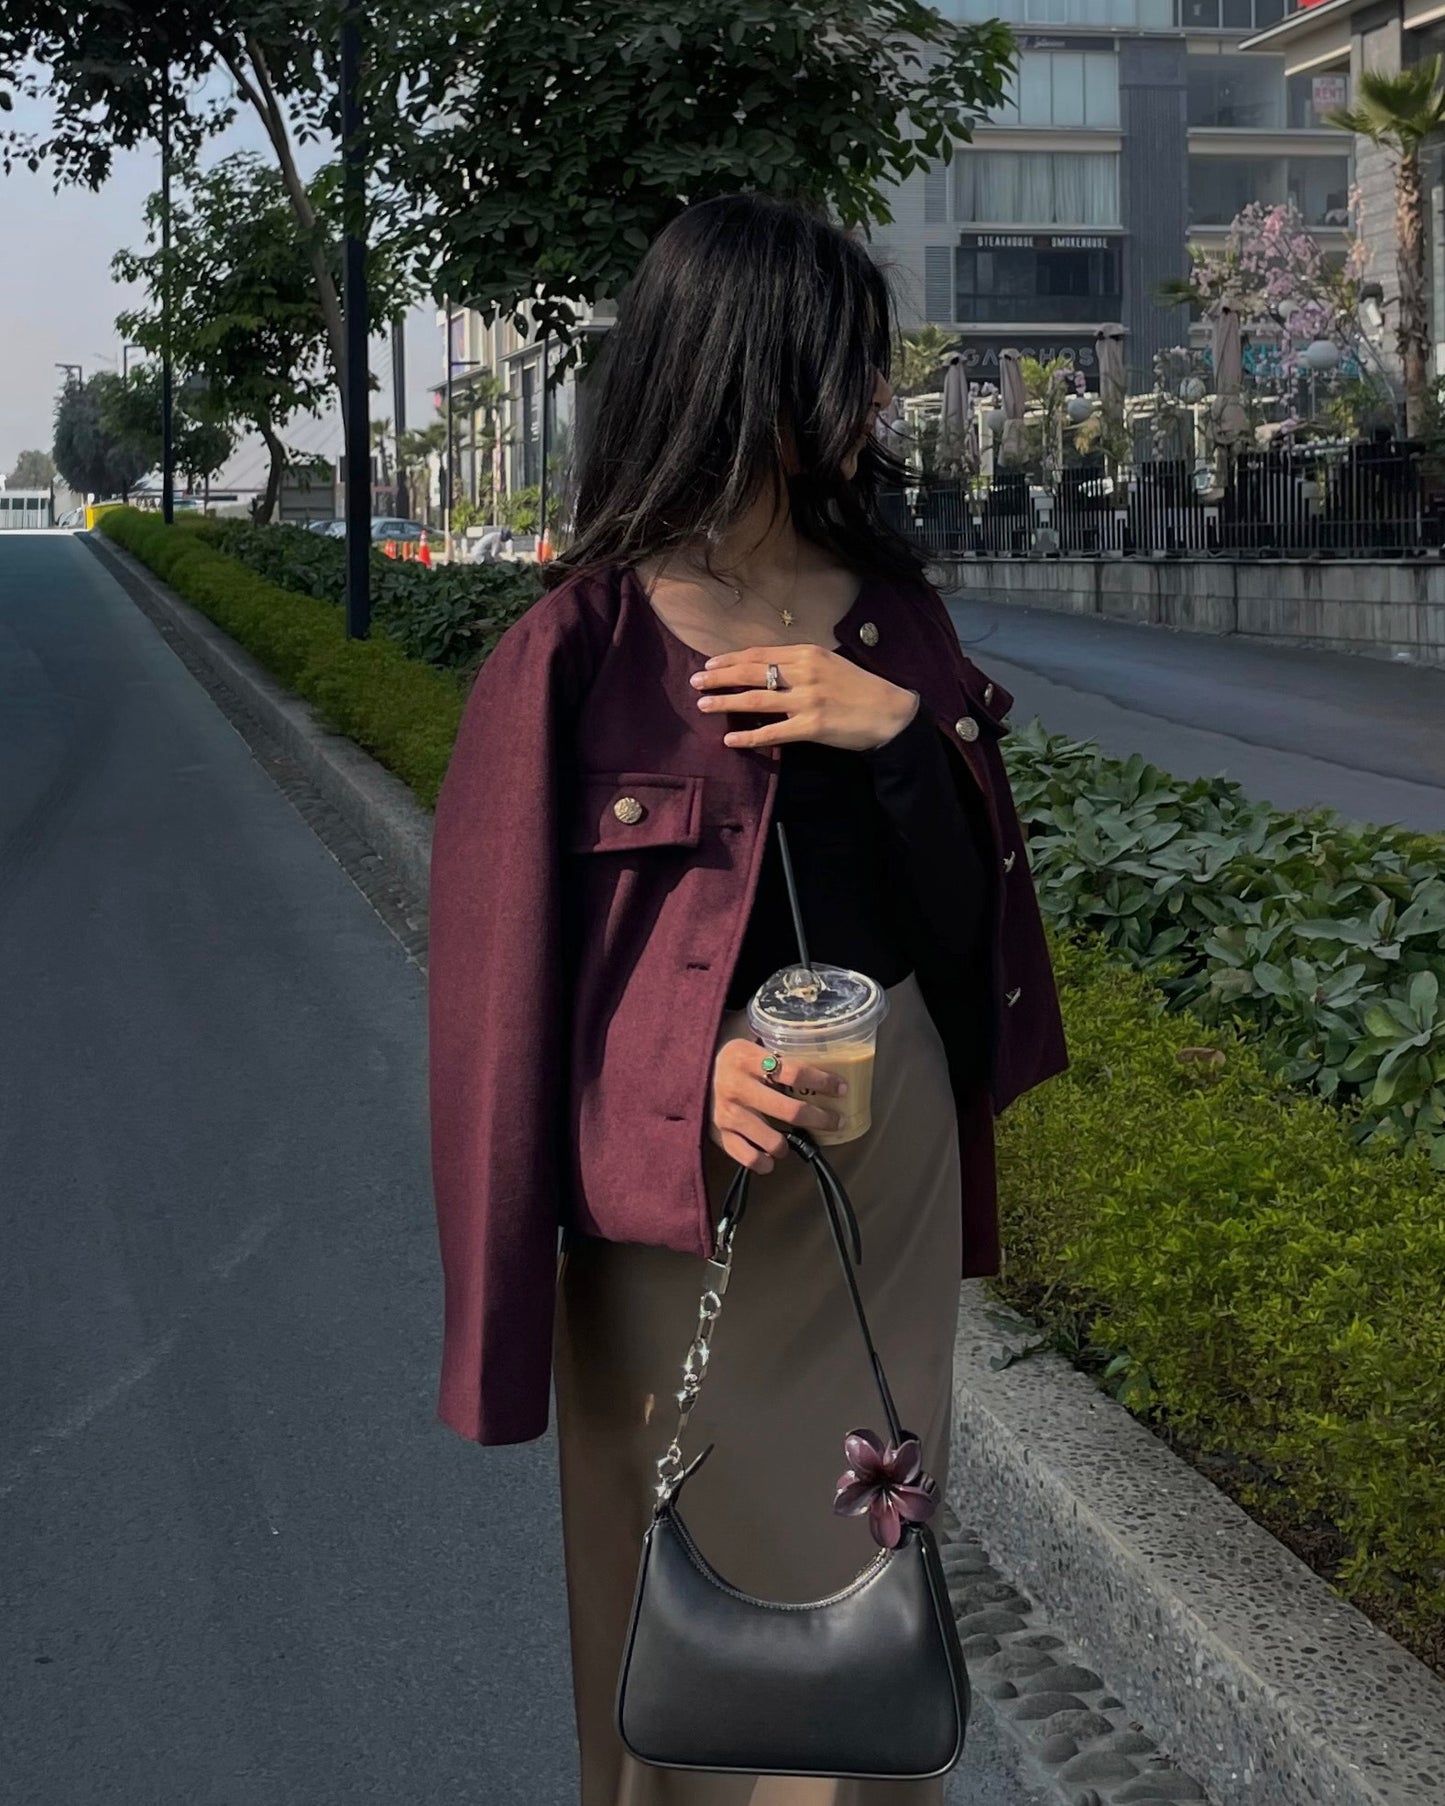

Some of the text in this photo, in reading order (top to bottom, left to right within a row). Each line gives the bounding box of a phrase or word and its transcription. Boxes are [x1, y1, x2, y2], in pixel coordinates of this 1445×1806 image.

[1314, 87, 1344, 100] RENT
[977, 235, 1108, 249] STEAKHOUSE SMOKEHOUSE
[962, 346, 1094, 367] GAHOS
